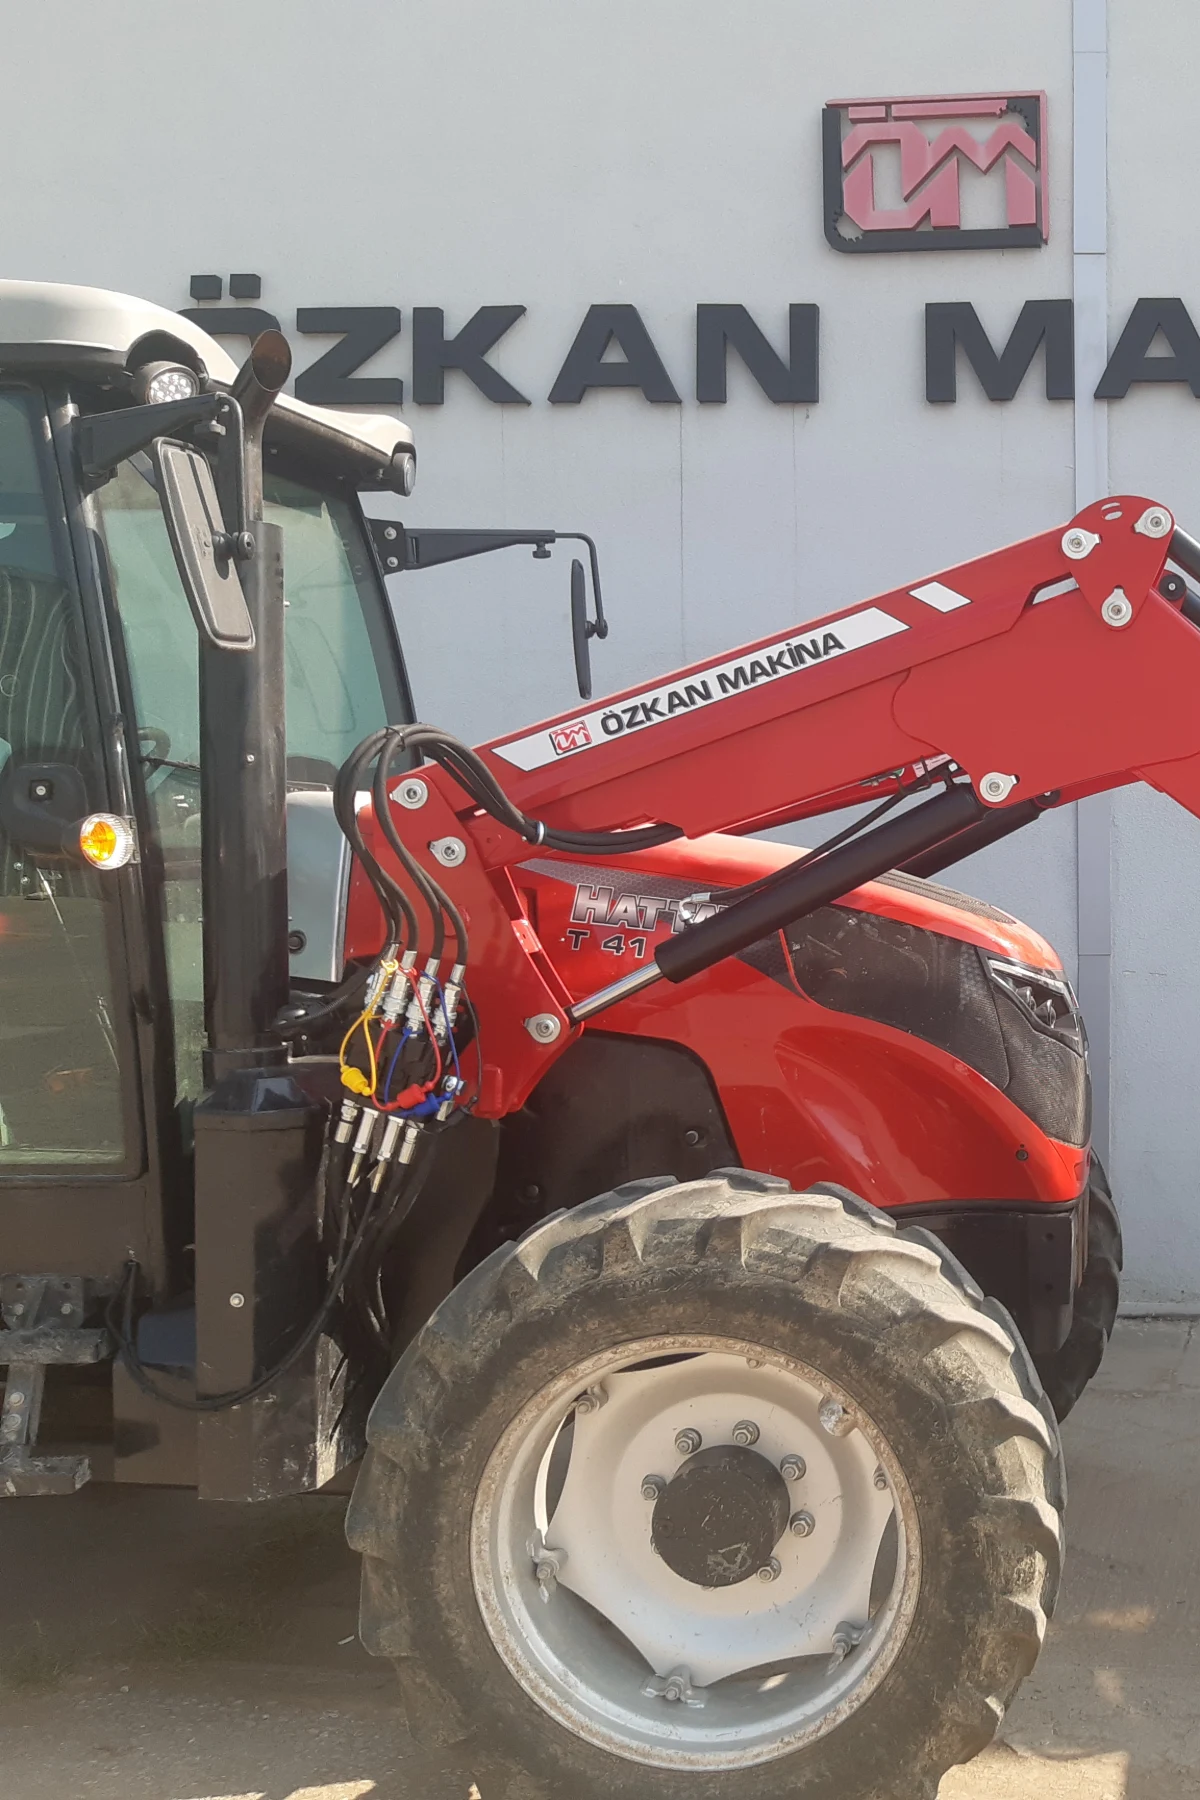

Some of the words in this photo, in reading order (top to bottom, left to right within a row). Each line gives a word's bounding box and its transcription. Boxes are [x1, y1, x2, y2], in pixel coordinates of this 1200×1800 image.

[600, 680, 713, 736] ÖZKAN
[716, 632, 846, 694] MAKİNA
[570, 883, 731, 935] HATT
[567, 928, 590, 951] T
[601, 933, 647, 959] 41
